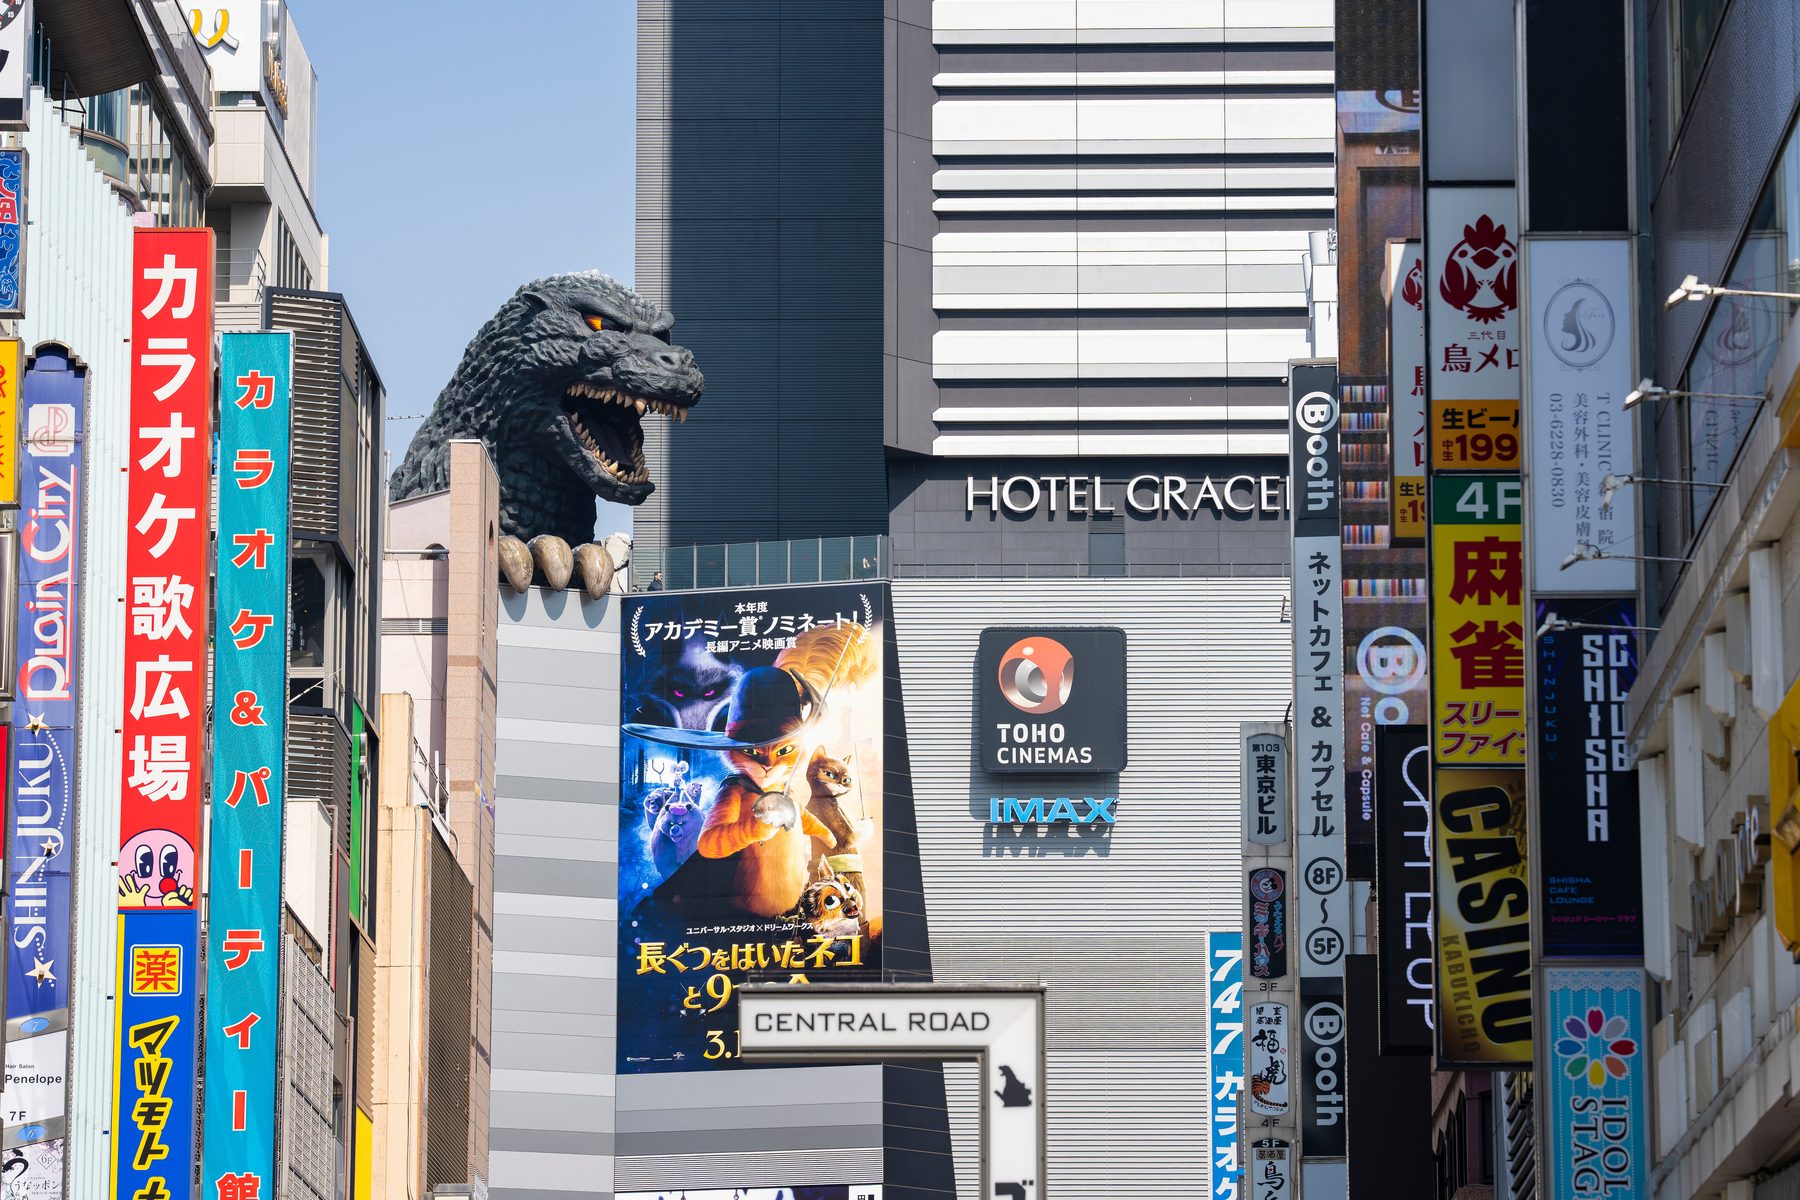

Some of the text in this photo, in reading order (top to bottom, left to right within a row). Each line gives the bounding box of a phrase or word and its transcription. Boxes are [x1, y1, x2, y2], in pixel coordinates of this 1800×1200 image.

[1467, 331, 1506, 340] 三代目
[1455, 432, 1519, 462] 199
[1597, 392, 1612, 472] T CLINIC
[1296, 391, 1340, 511] Booth
[1549, 393, 1565, 508] 03-6228-0830
[967, 475, 1290, 512] HOTEL GRACE
[1456, 481, 1521, 519] 4F
[128, 254, 198, 802] カラオケ歌広場
[734, 601, 768, 615] 本年度
[1449, 536, 1523, 690] 麻雀
[705, 636, 797, 654] 長編アニメ映画賞
[1360, 697, 1371, 719] Net
[1441, 701, 1521, 727] スリー
[997, 723, 1066, 744] TOHO
[1252, 743, 1280, 752] 第103
[1441, 729, 1525, 757] ファイ
[997, 747, 1093, 764] CINEMAS
[1256, 754, 1278, 835] 東京ビル
[1360, 769, 1373, 820] Capsule
[990, 797, 1118, 823] IMAX
[13, 743, 64, 949] SHINJUKU
[1549, 896, 1596, 905] LOUNGE
[636, 934, 864, 976] 長ぐつをはいたネコ
[136, 950, 177, 991] 薬
[1442, 935, 1481, 1053] KABUKICHO
[755, 1012, 990, 1032] CENTRAL ROAD
[1304, 1001, 1344, 1126] Booth
[4, 1074, 62, 1085] Penelope
[9, 1110, 27, 1121] 7F
[1261, 1118, 1280, 1128] 4F
[1262, 1139, 1280, 1148] 5F
[1571, 1096, 1601, 1200] STAG
[1601, 1097, 1630, 1196] IDOL
